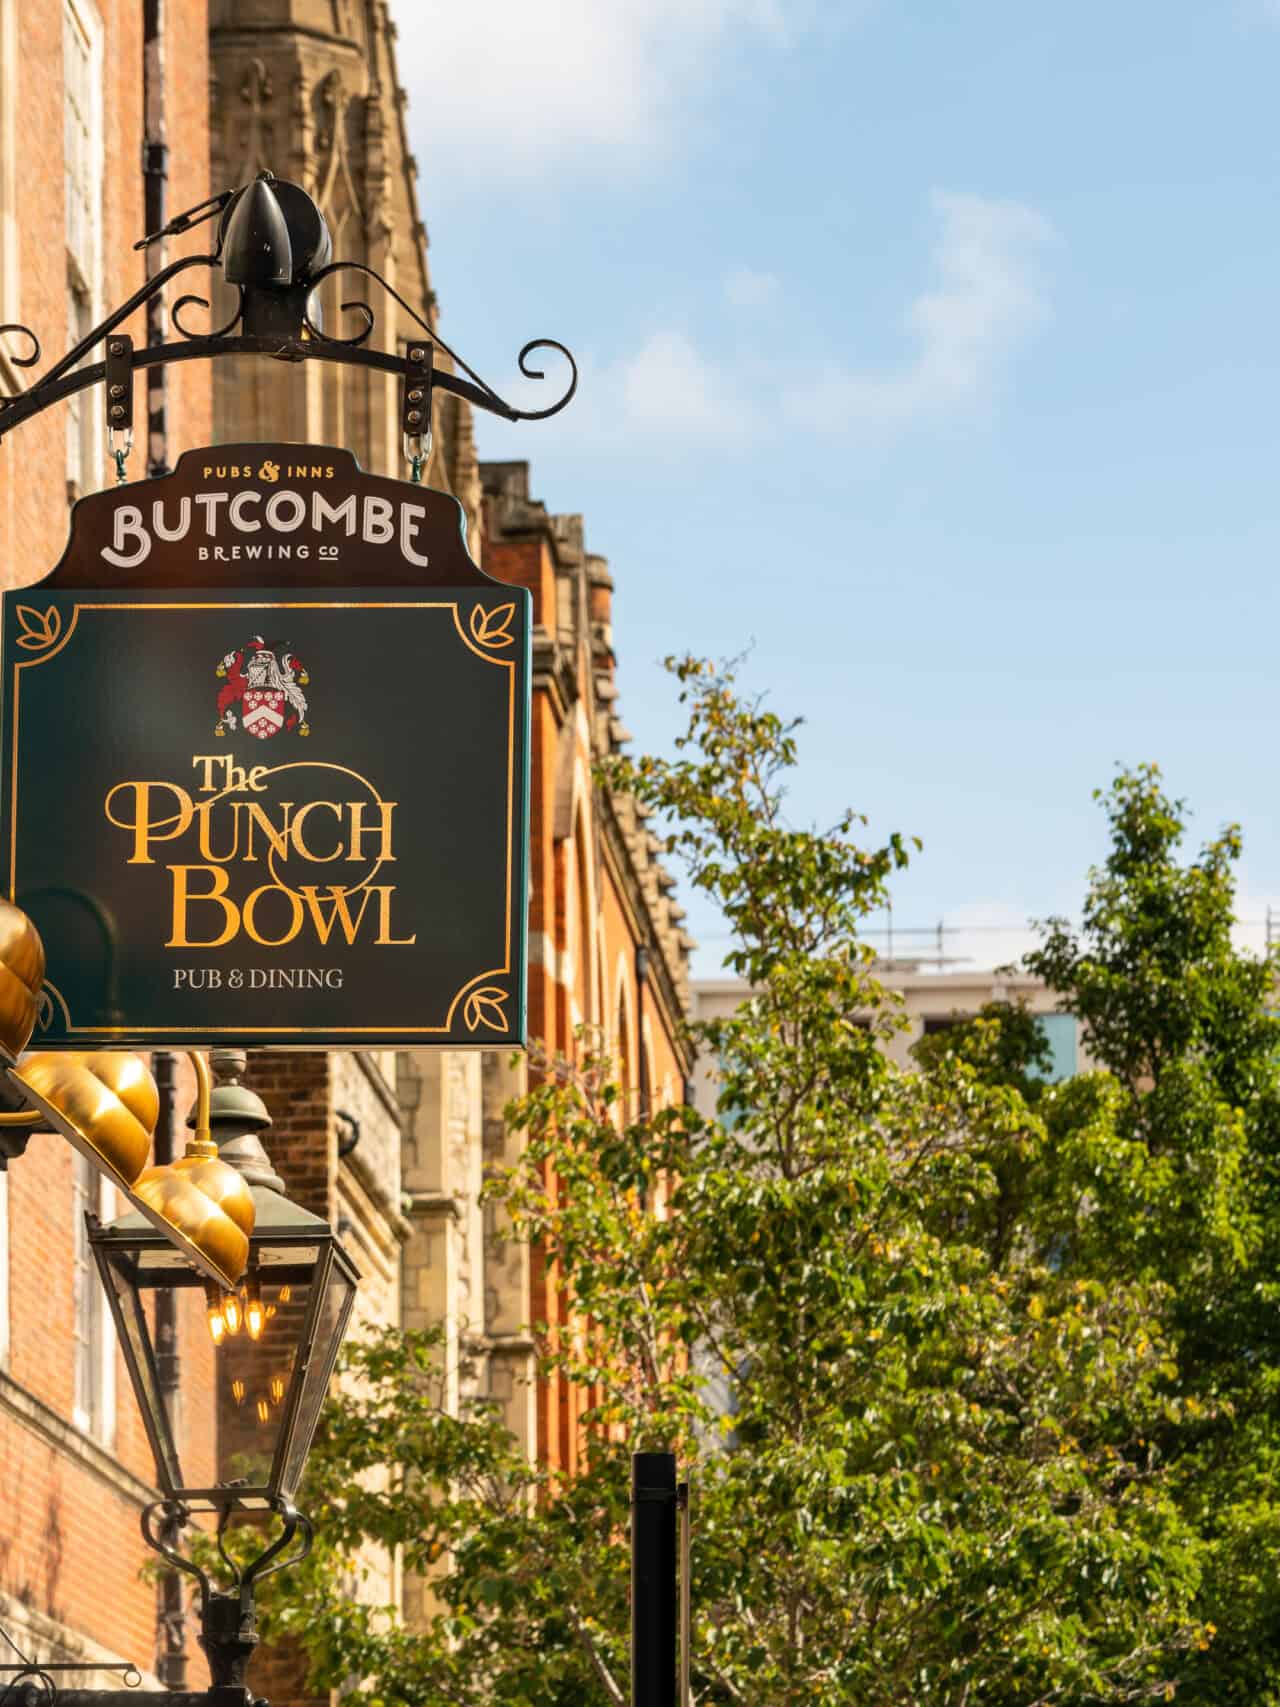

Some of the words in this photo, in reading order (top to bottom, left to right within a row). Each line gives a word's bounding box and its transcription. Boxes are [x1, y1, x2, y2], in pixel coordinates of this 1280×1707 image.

[203, 465, 253, 479] PUBS
[258, 460, 281, 482] &
[286, 465, 336, 479] INNS
[100, 489, 429, 568] BUTCOMBE
[198, 544, 310, 561] BREWING
[192, 753, 269, 792] The
[104, 780, 399, 864] PUNCH
[164, 864, 417, 947] BOWL
[173, 968, 222, 989] PUB
[228, 968, 245, 989] &
[248, 968, 345, 989] DINING
